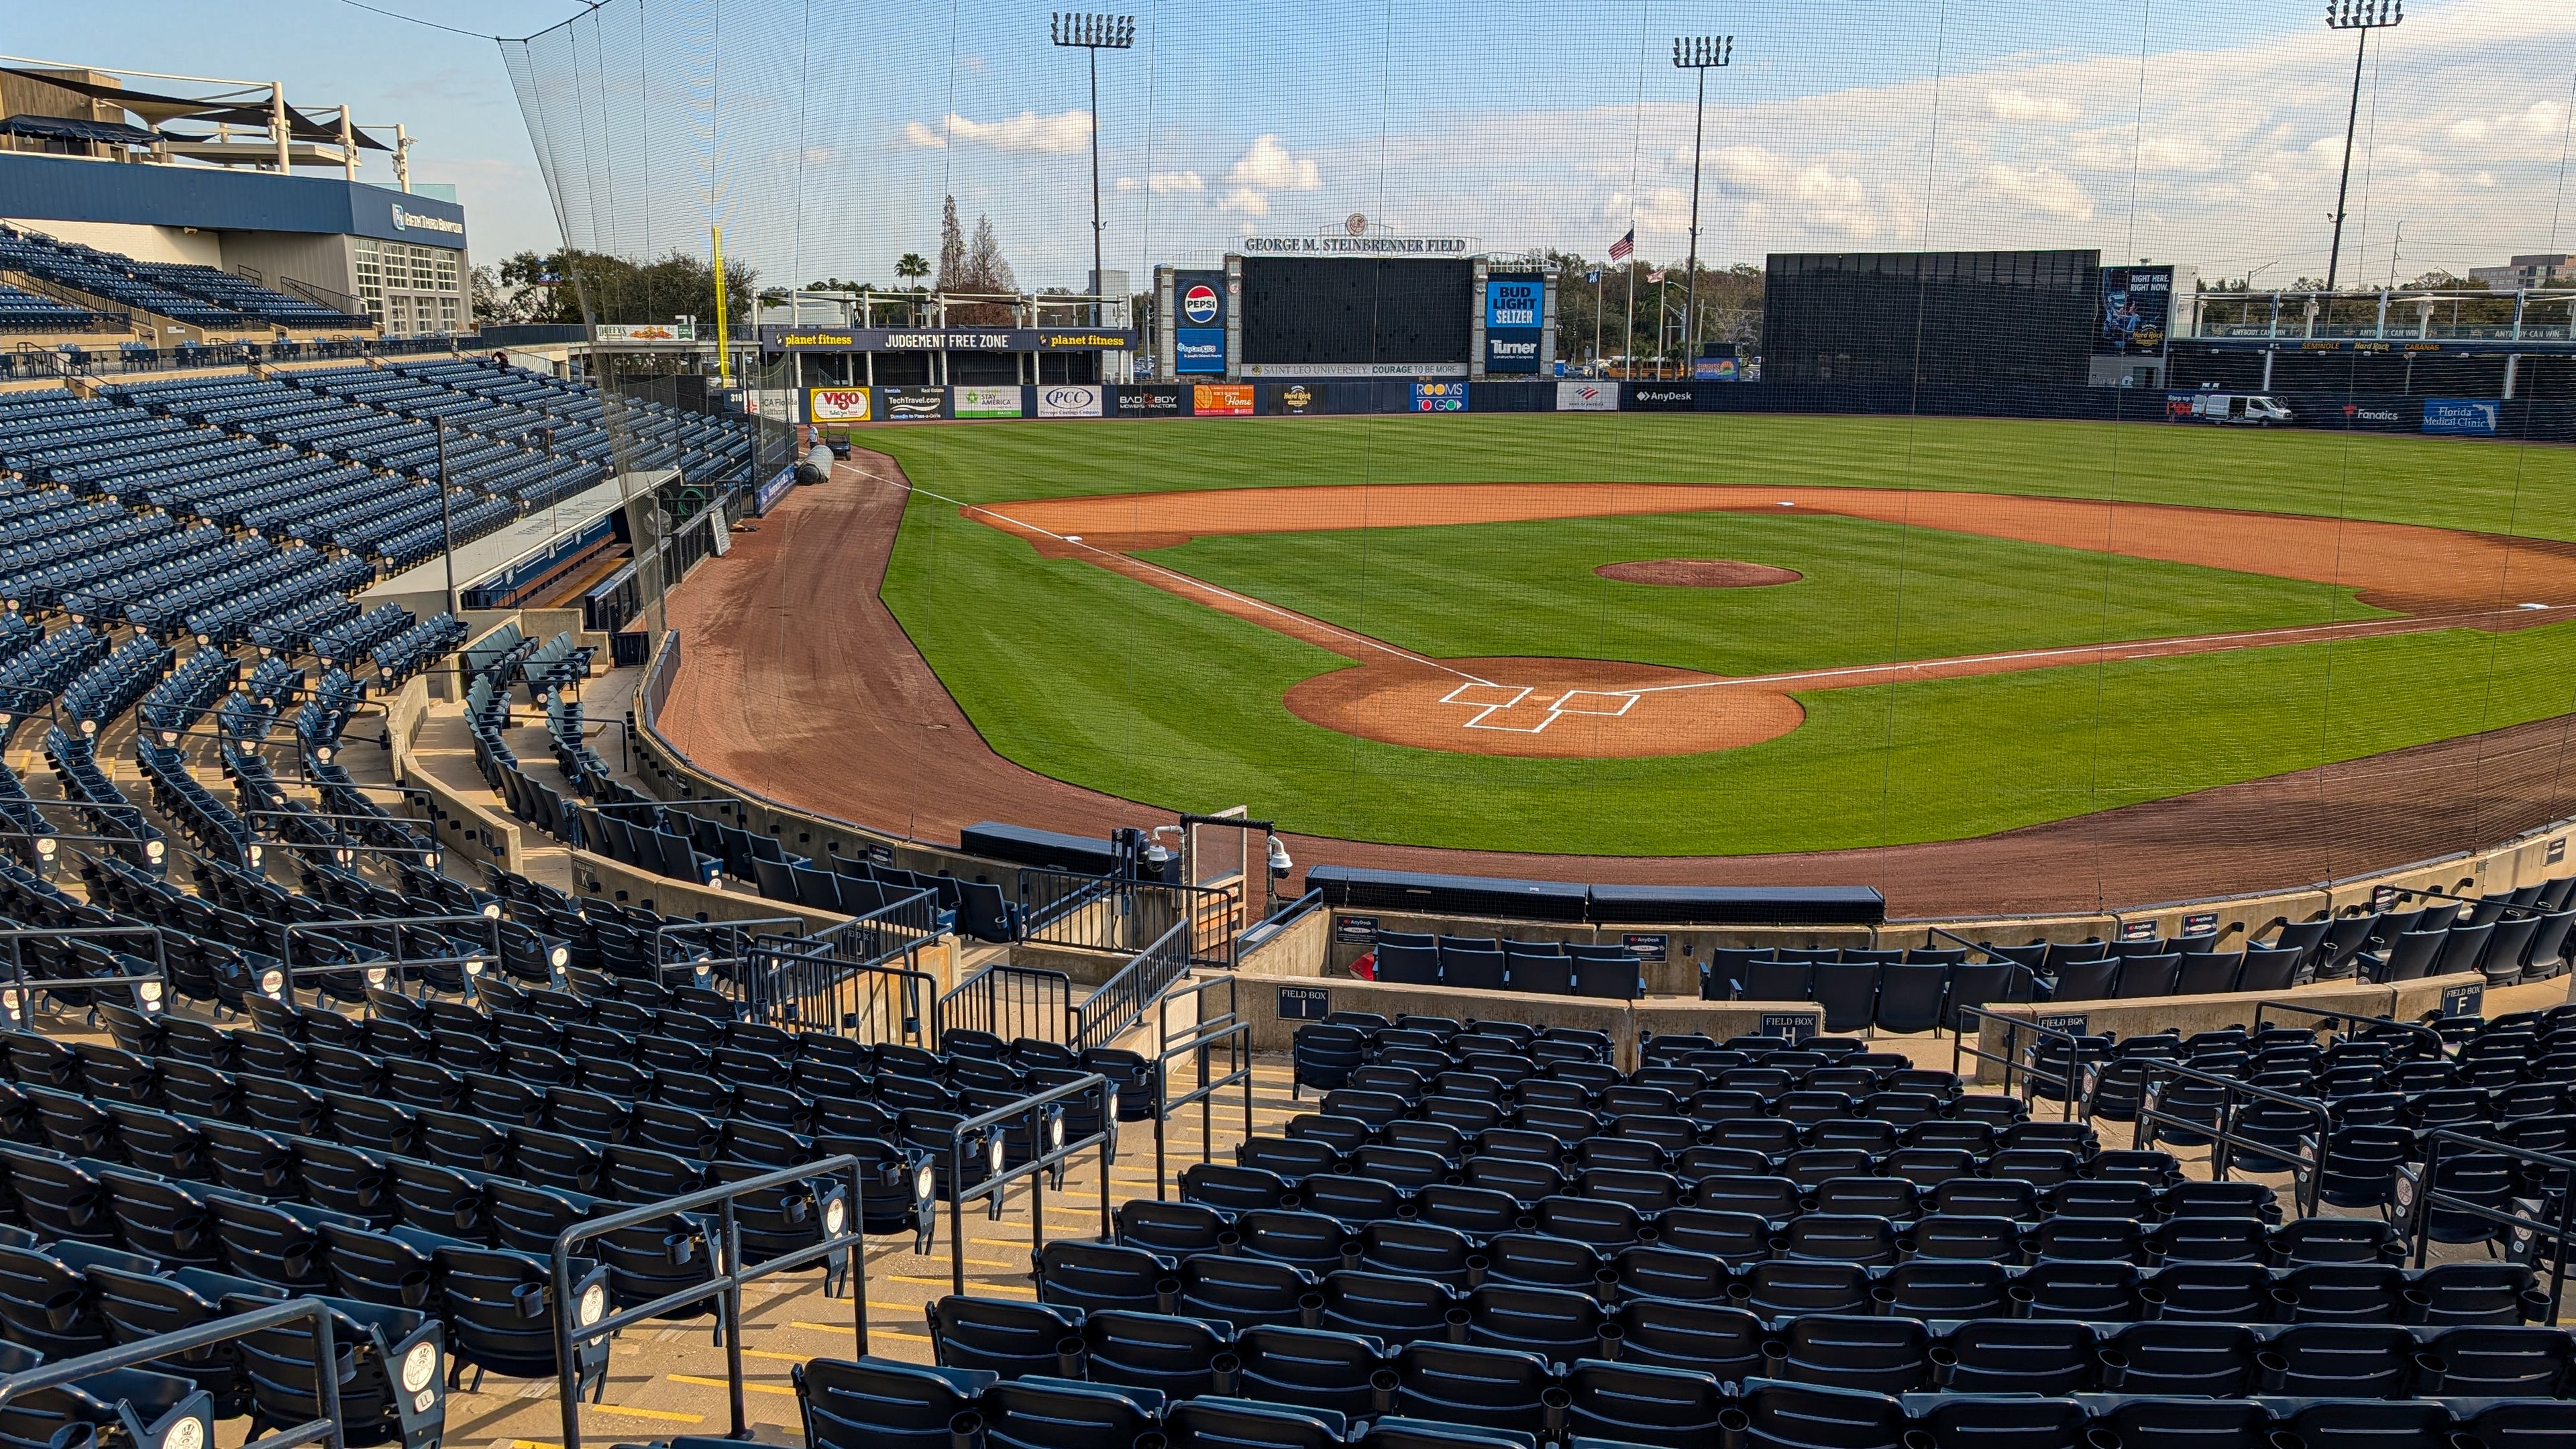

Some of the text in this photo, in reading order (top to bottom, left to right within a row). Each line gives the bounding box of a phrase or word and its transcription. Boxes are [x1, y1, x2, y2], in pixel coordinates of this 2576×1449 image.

[1246, 238, 1466, 252] GEORGE M. STEINBRENNER FIELD
[2131, 274, 2169, 282] RIGHT HERE.
[1499, 286, 1531, 298] BUD
[2130, 283, 2169, 292] RIGHT NOW.
[1187, 300, 1216, 309] PEPSI
[1493, 298, 1537, 309] LIGHT
[1496, 310, 1533, 324] SELTZER
[598, 325, 627, 337] DUFFY'S
[2149, 331, 2163, 339] Rock
[785, 334, 852, 347] planet fitness
[885, 334, 1009, 348] JUDGEMENT FREE ZONE
[1051, 335, 1124, 347] planet fitness
[1490, 339, 1538, 354] Turner
[2372, 342, 2390, 351] Rock
[1264, 366, 1293, 375] SAINT
[1293, 366, 1312, 375] LEO
[1373, 366, 1412, 374] COURAGE
[1413, 366, 1424, 374] TO
[1425, 366, 1435, 374] BE
[1416, 383, 1462, 396] ROOMS
[731, 393, 743, 402] 318
[888, 396, 941, 405] TechTravel.com
[1053, 391, 1083, 403] PCC
[1225, 394, 1252, 406] Home
[1284, 392, 1311, 400] Hard Rock
[1651, 392, 1692, 401] AnyDesk
[1416, 399, 1457, 411] TO GO
[2357, 409, 2398, 421] Fanatics
[2438, 407, 2471, 417] Florida
[2424, 415, 2485, 427] Medical Clinic
[581, 871, 590, 887] K
[856, 940, 863, 956] J
[1281, 989, 1326, 1000] FIELD BOX
[2447, 985, 2481, 998] FIELD BOX
[2457, 997, 2468, 1014] F
[2041, 1016, 2086, 1028] FIELD BOX
[1782, 1026, 1796, 1044] H
[2515, 1242, 2523, 1251] GG
[420, 1395, 431, 1407] LL
